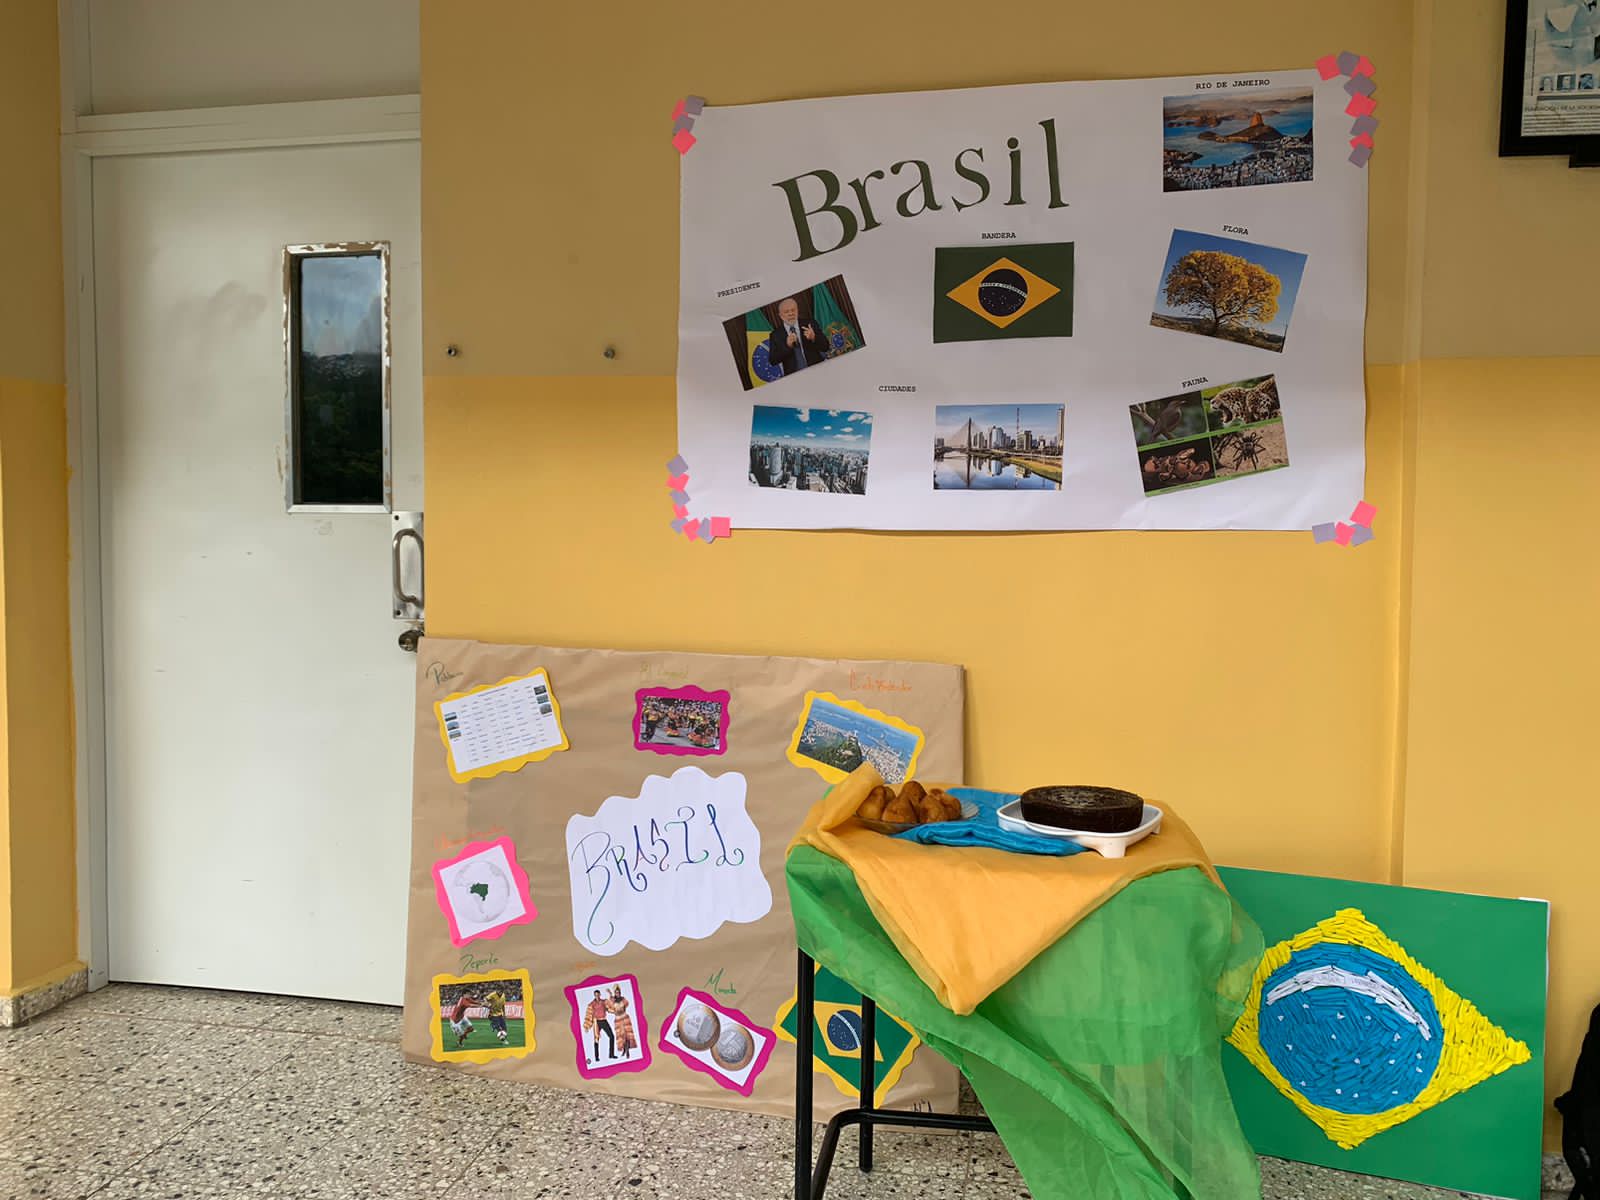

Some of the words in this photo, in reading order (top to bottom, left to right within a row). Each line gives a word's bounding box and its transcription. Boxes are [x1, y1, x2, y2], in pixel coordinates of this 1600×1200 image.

[1195, 80, 1213, 90] RIO
[1216, 80, 1229, 89] DE
[1231, 79, 1271, 89] JANEIRO
[772, 118, 1069, 262] Brasil
[981, 231, 1017, 240] BANDERA
[1222, 224, 1249, 236] FLORA
[717, 282, 761, 298] PRESIDENTE
[1182, 376, 1209, 389] FAUNA
[878, 385, 917, 393] CIUDADES
[572, 804, 744, 946] BRASIL
